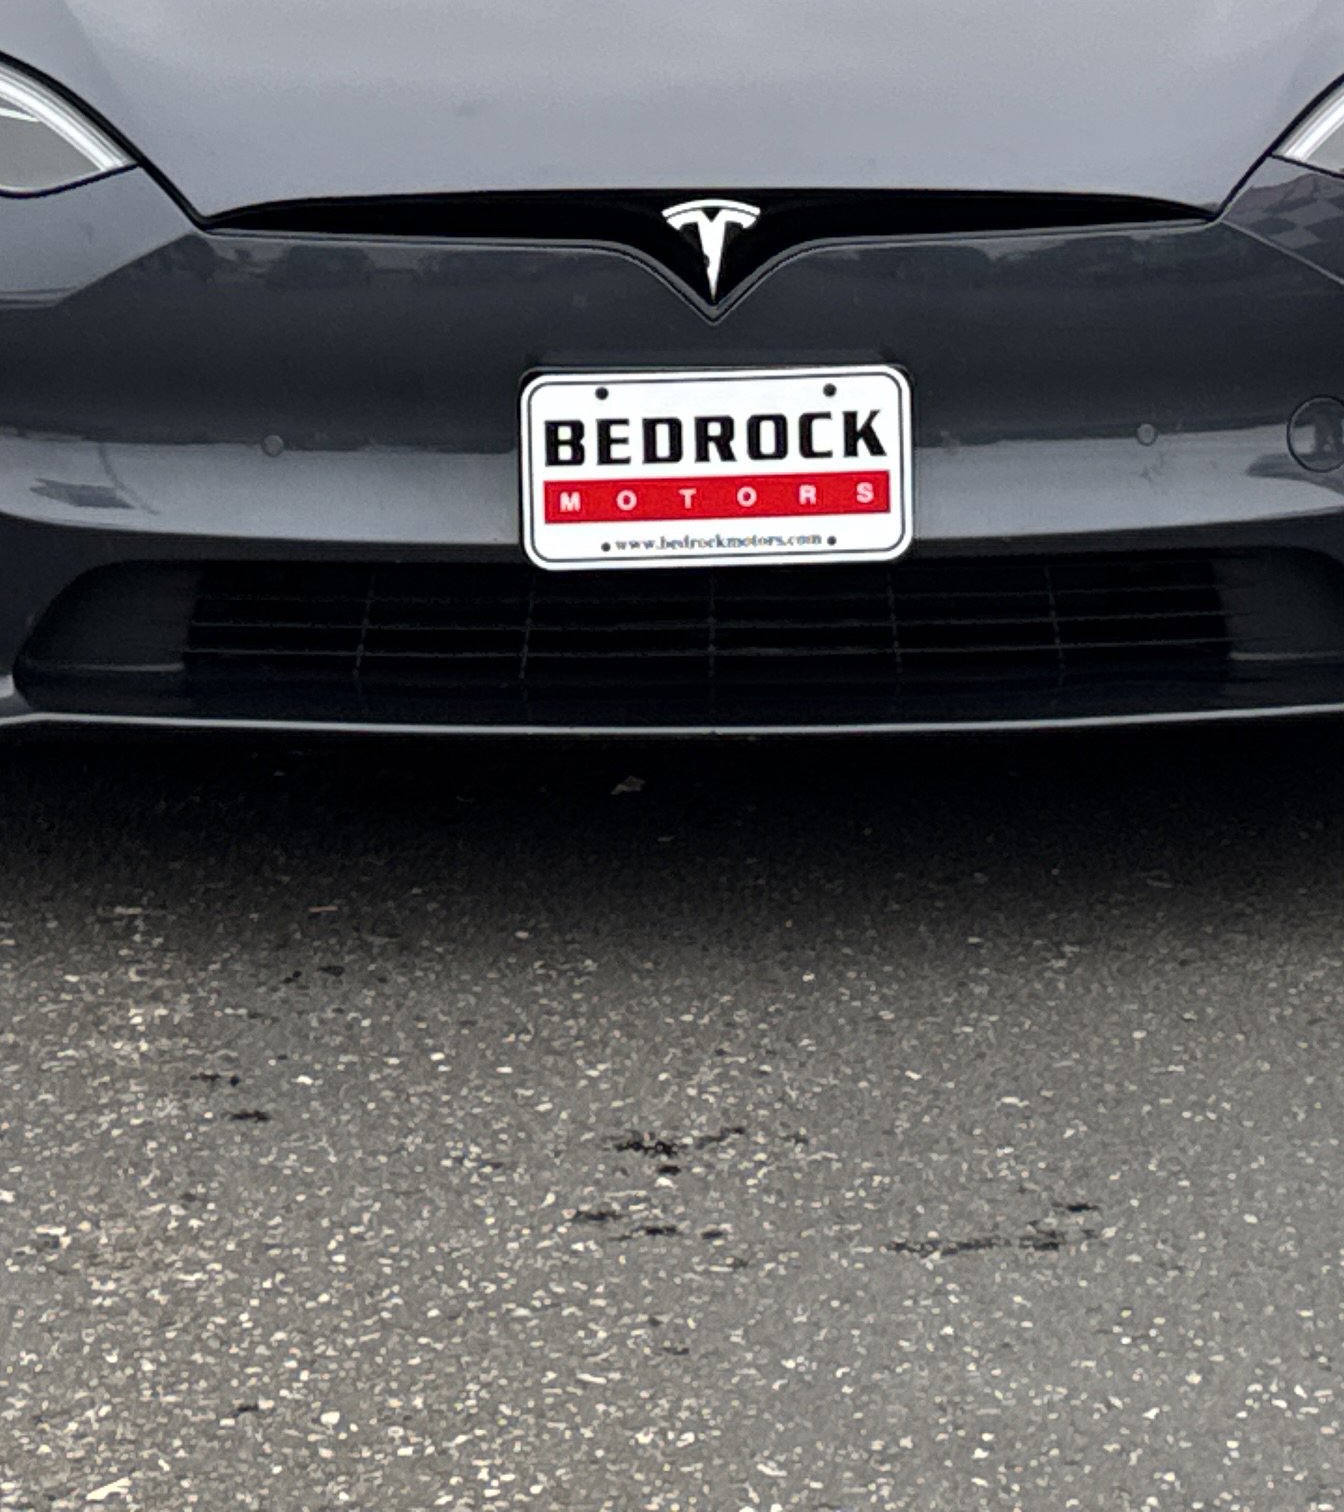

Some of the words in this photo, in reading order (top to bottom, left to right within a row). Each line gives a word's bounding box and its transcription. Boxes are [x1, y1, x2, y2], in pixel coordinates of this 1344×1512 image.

[544, 409, 887, 467] BEDROCK
[559, 482, 874, 513] MOTORS
[614, 532, 822, 551] www.bedrockmotors.com
